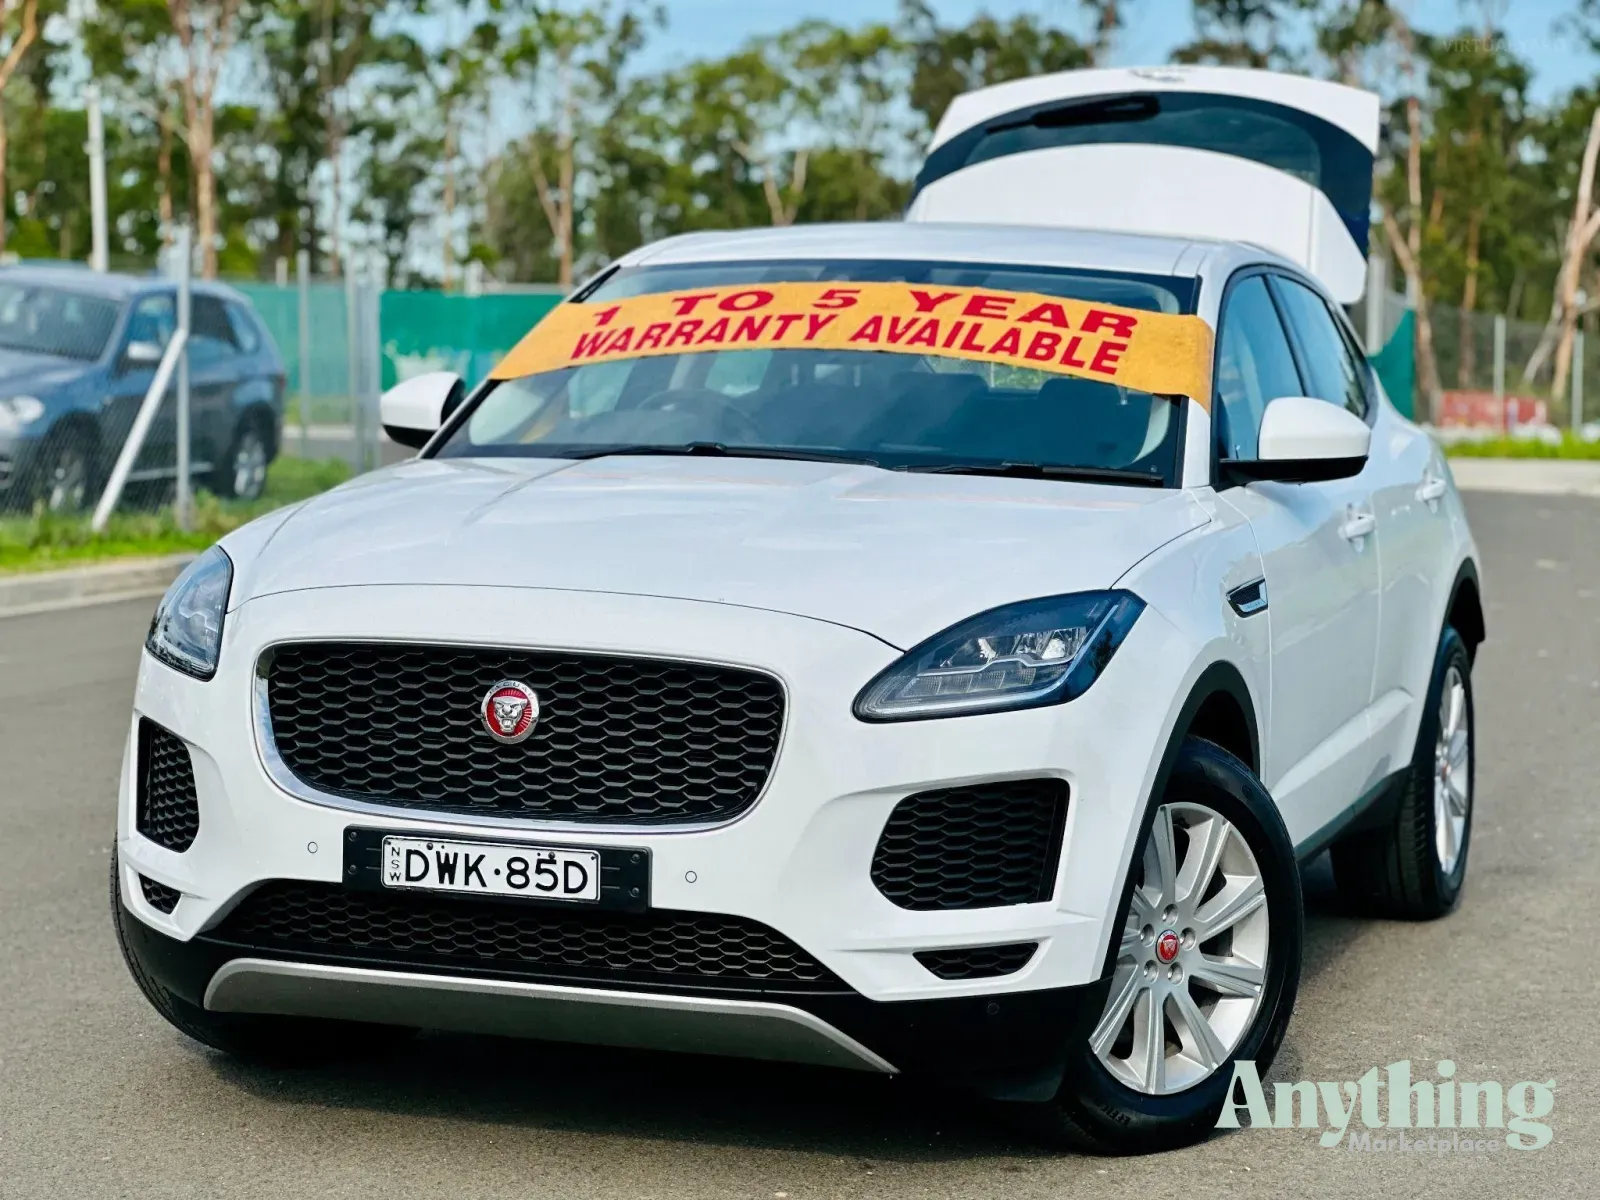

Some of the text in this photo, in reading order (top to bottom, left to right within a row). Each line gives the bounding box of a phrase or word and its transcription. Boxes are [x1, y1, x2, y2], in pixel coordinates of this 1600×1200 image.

[595, 287, 1139, 340] 1 TO 5 YEAR
[570, 312, 1129, 377] WARRANTY AVAILABLE
[389, 846, 402, 882] NSW
